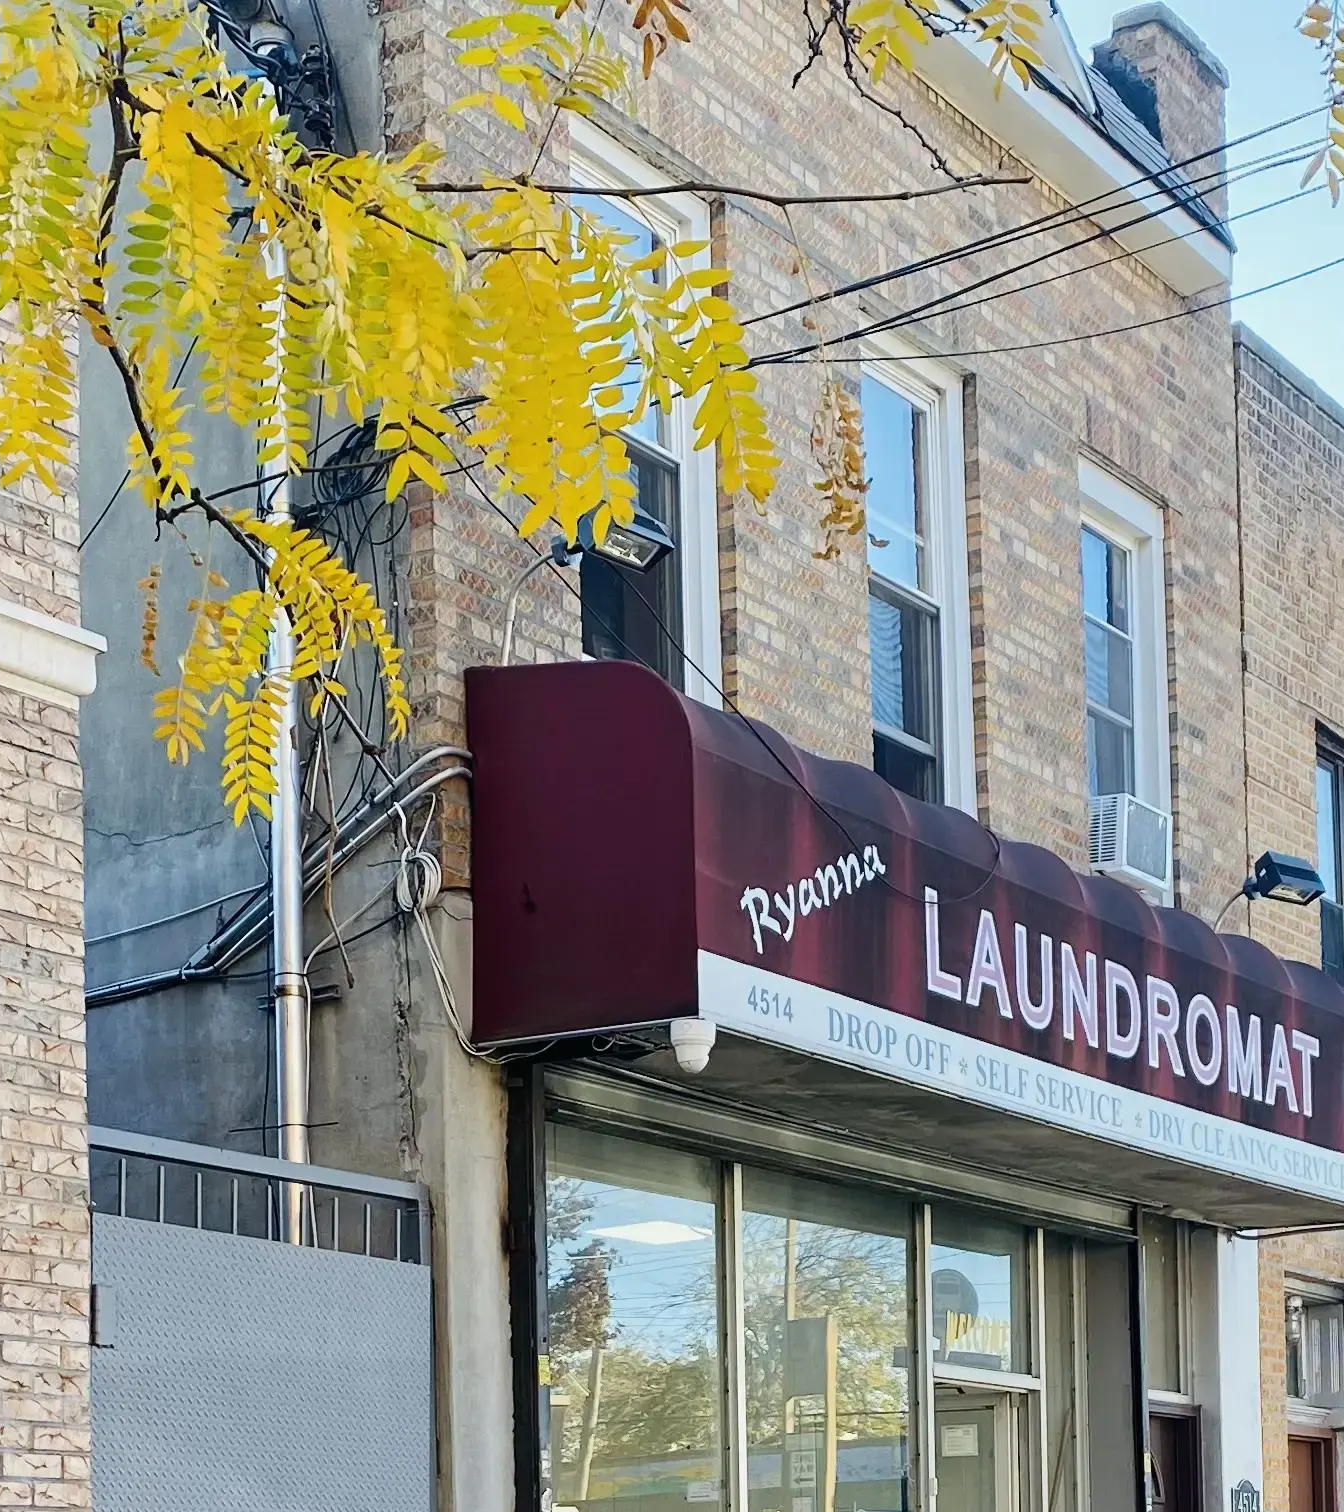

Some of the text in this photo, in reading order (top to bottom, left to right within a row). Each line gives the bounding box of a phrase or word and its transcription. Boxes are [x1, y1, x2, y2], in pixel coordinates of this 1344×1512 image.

[740, 845, 886, 954] Ryanna
[747, 985, 793, 1022] 4514
[827, 1006, 897, 1058] DROP
[906, 1033, 951, 1074] OFF
[975, 1054, 1028, 1099] SELF
[1035, 1073, 1123, 1128] SERVICE
[1148, 1108, 1186, 1145] DRY
[1191, 1122, 1278, 1171] CLEANING
[923, 885, 1319, 1118] LAUNDROMAT
